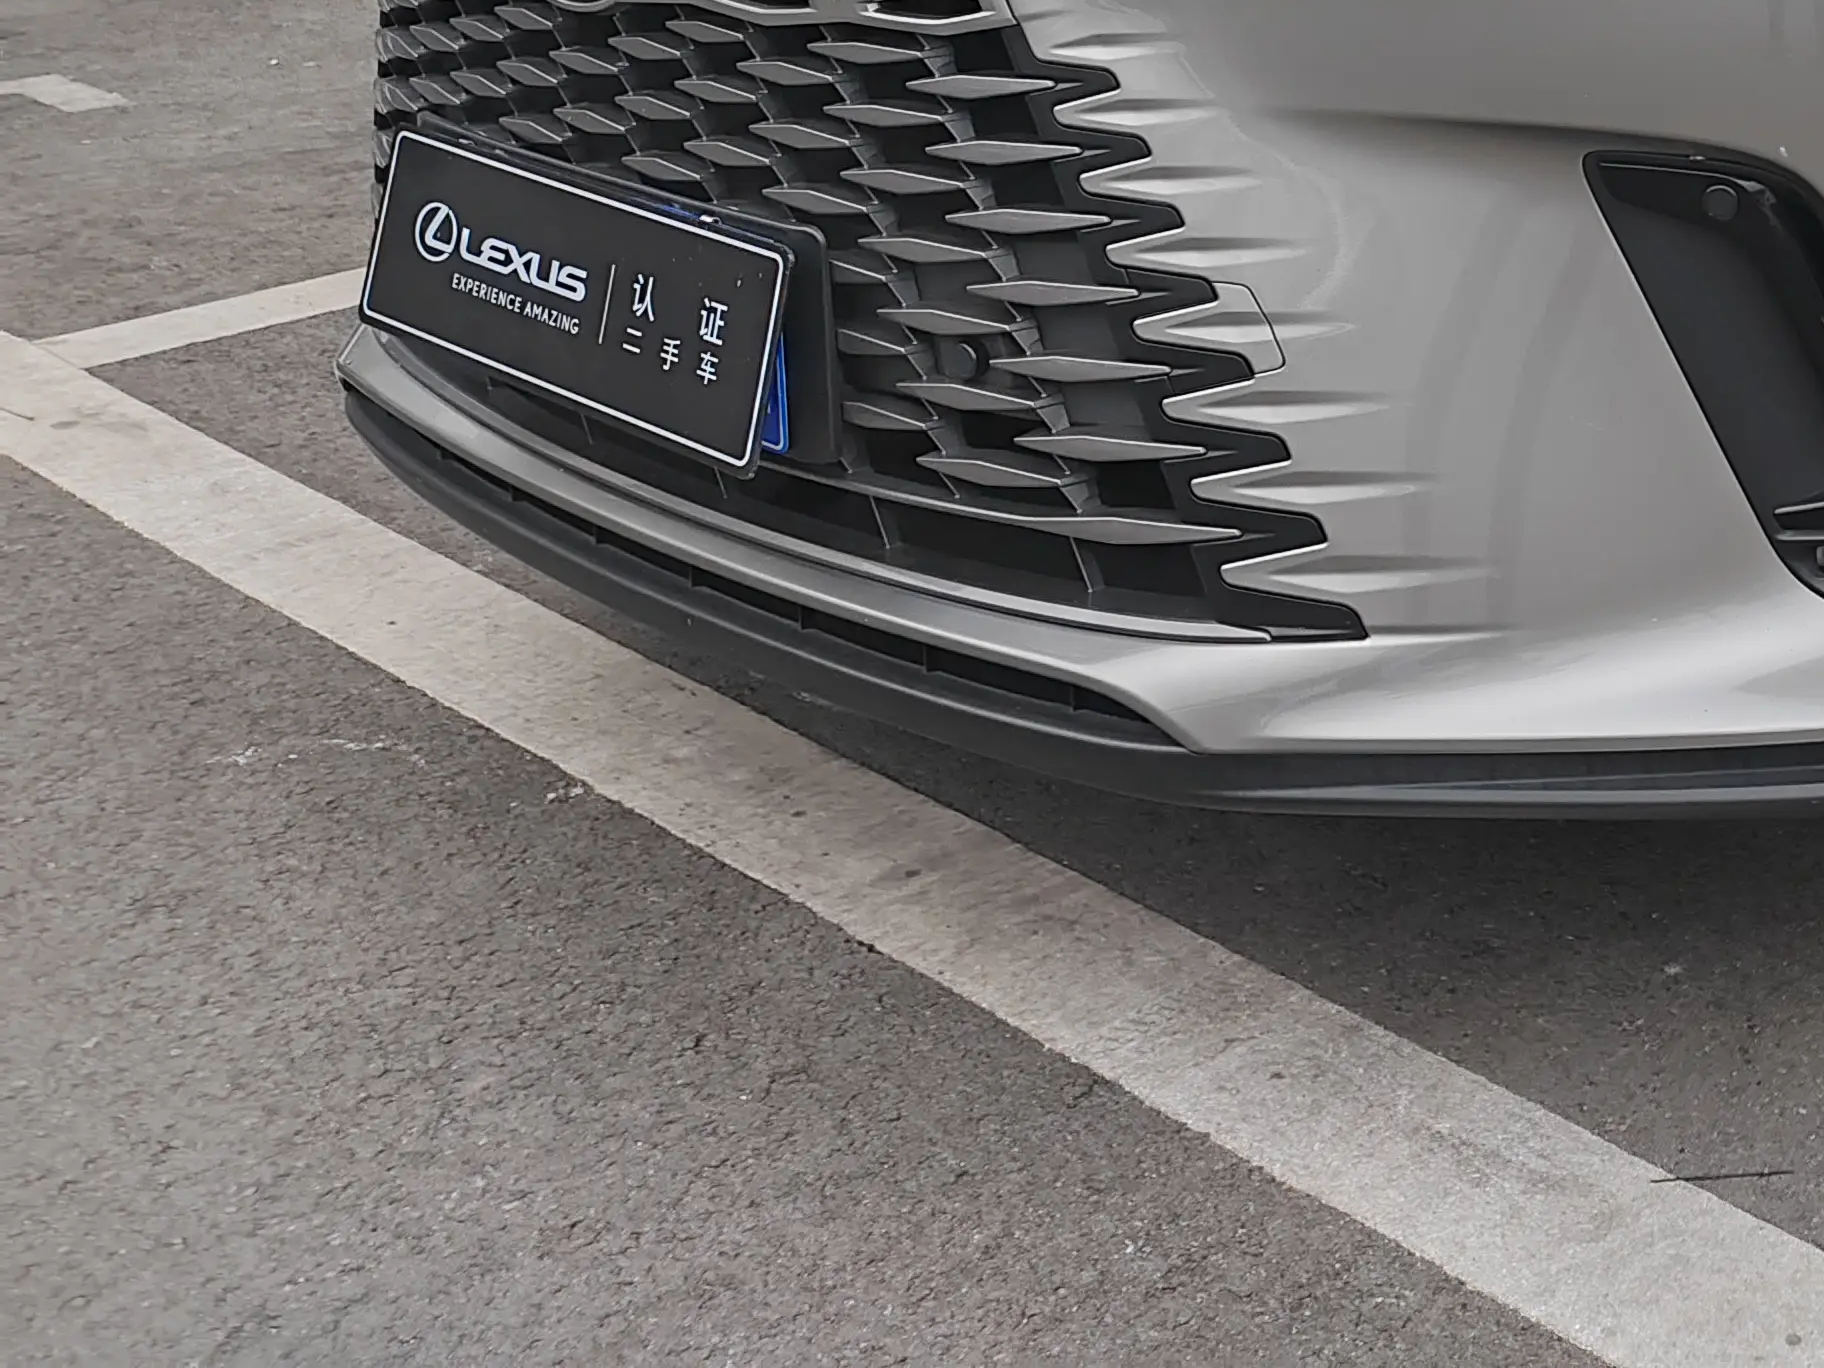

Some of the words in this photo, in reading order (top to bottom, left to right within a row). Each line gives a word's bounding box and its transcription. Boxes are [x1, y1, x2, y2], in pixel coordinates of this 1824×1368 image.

[459, 227, 588, 302] LEXUS
[452, 272, 523, 313] EXPERIENCE
[523, 300, 580, 335] AMAZING
[622, 327, 719, 384] 二手车
